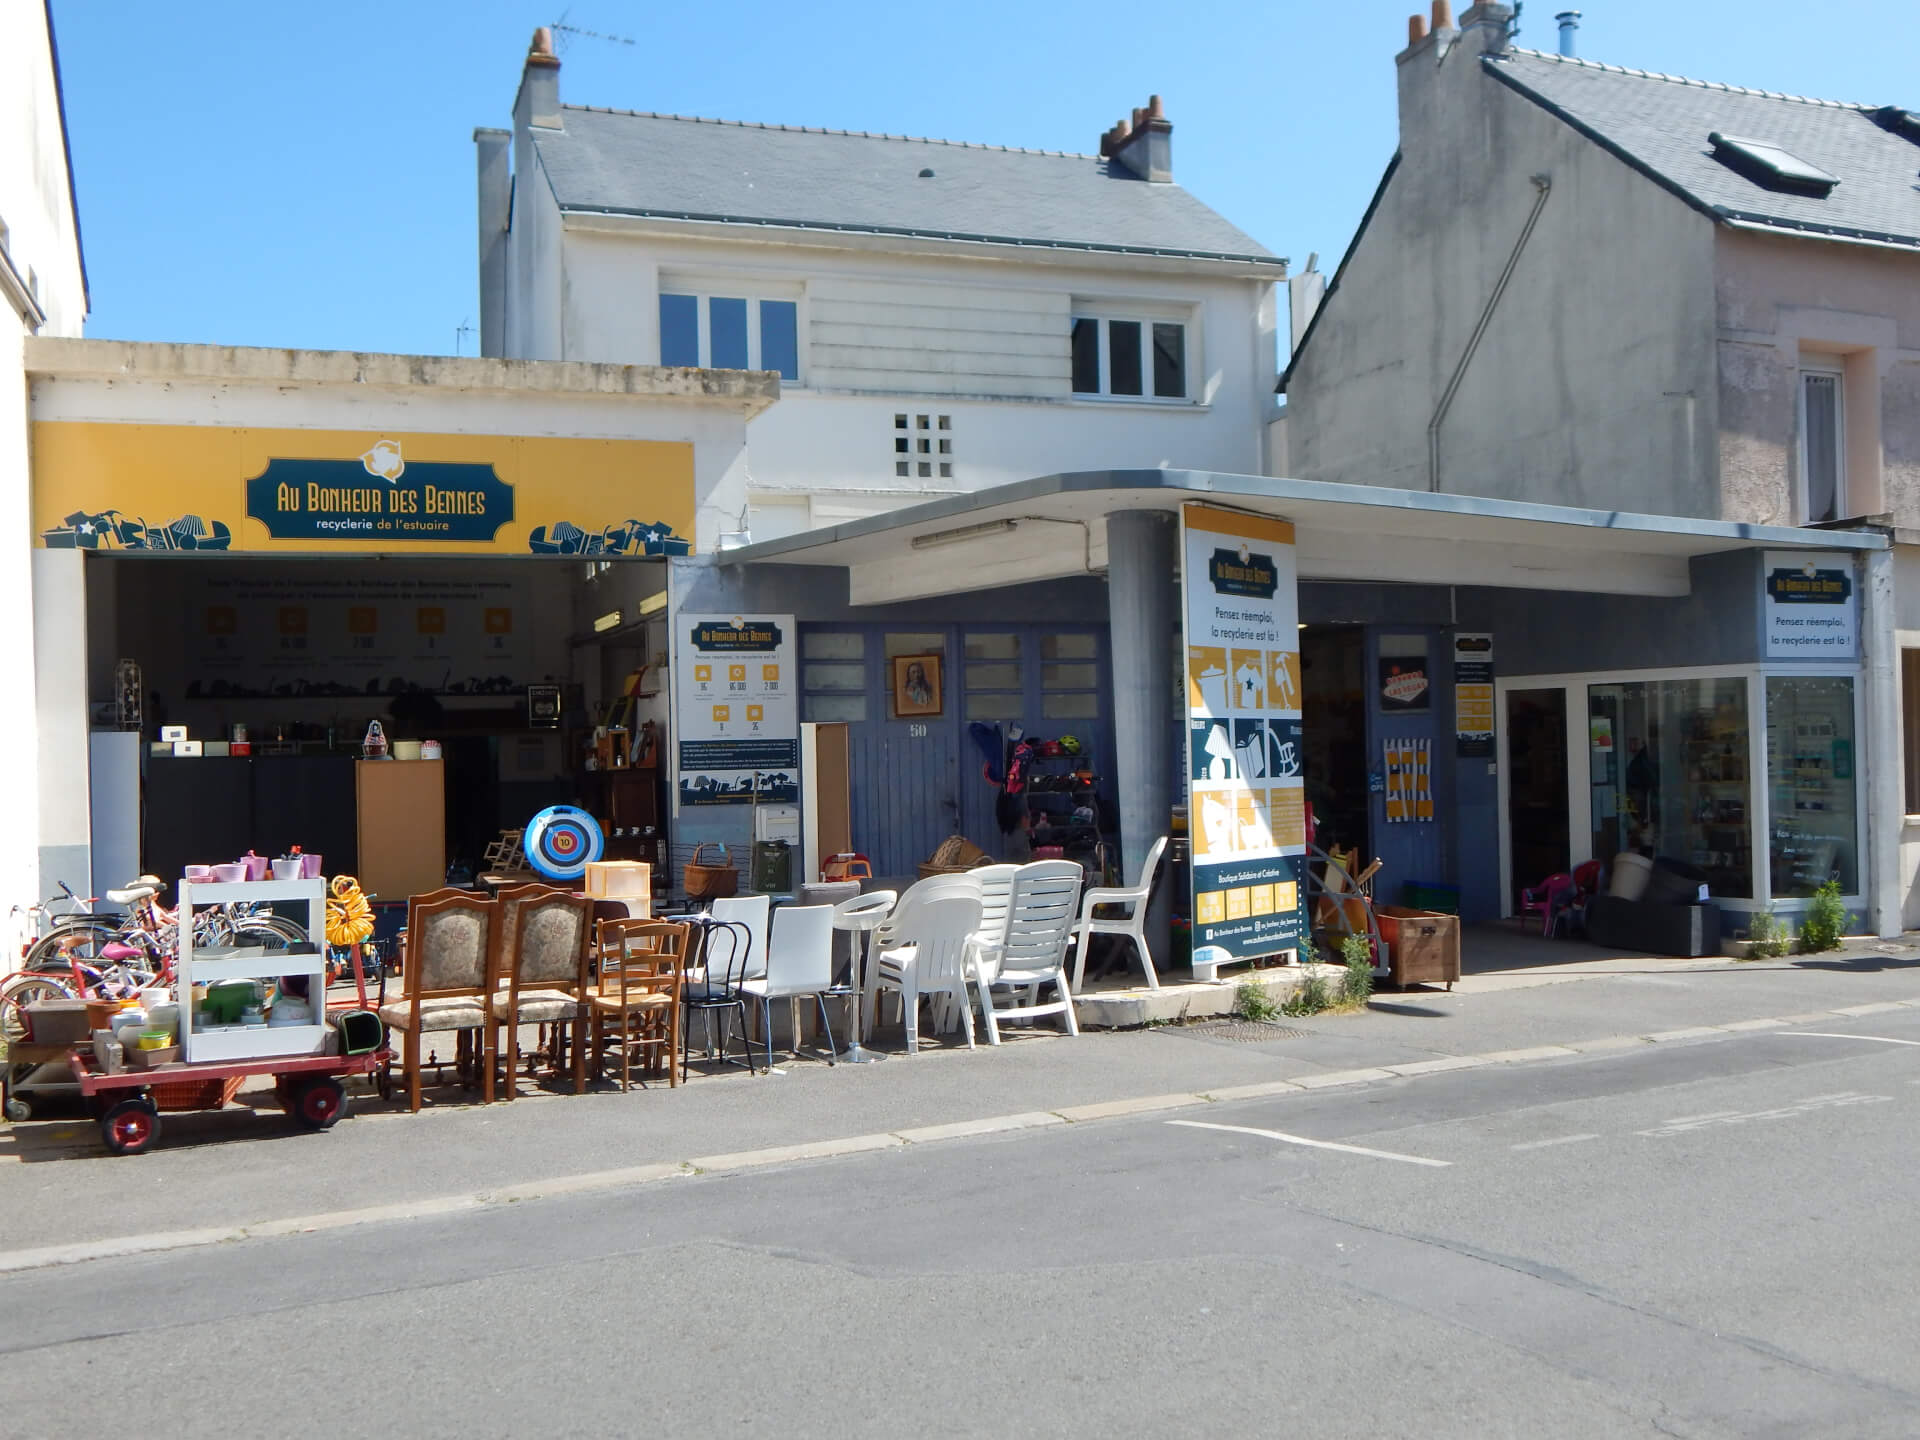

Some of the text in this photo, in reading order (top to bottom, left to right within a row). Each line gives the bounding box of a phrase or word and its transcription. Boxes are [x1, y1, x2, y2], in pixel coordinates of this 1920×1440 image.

[277, 481, 486, 514] AU BONHEUR DES BENNES
[316, 519, 449, 531] recyclerie de l'estuaire
[1215, 606, 1274, 624] Pensez réemploi,
[1776, 616, 1845, 628] Pensez réemploi,
[1211, 624, 1219, 637] la
[1221, 627, 1254, 641] recyclerie
[1256, 630, 1266, 641] est
[1267, 629, 1275, 642] là
[1771, 635, 1779, 644] la
[1781, 635, 1820, 646] recyclerie
[910, 724, 927, 736] 50
[560, 838, 570, 847] 10
[1218, 874, 1238, 883] Boutique
[1238, 871, 1257, 881] Solidaire
